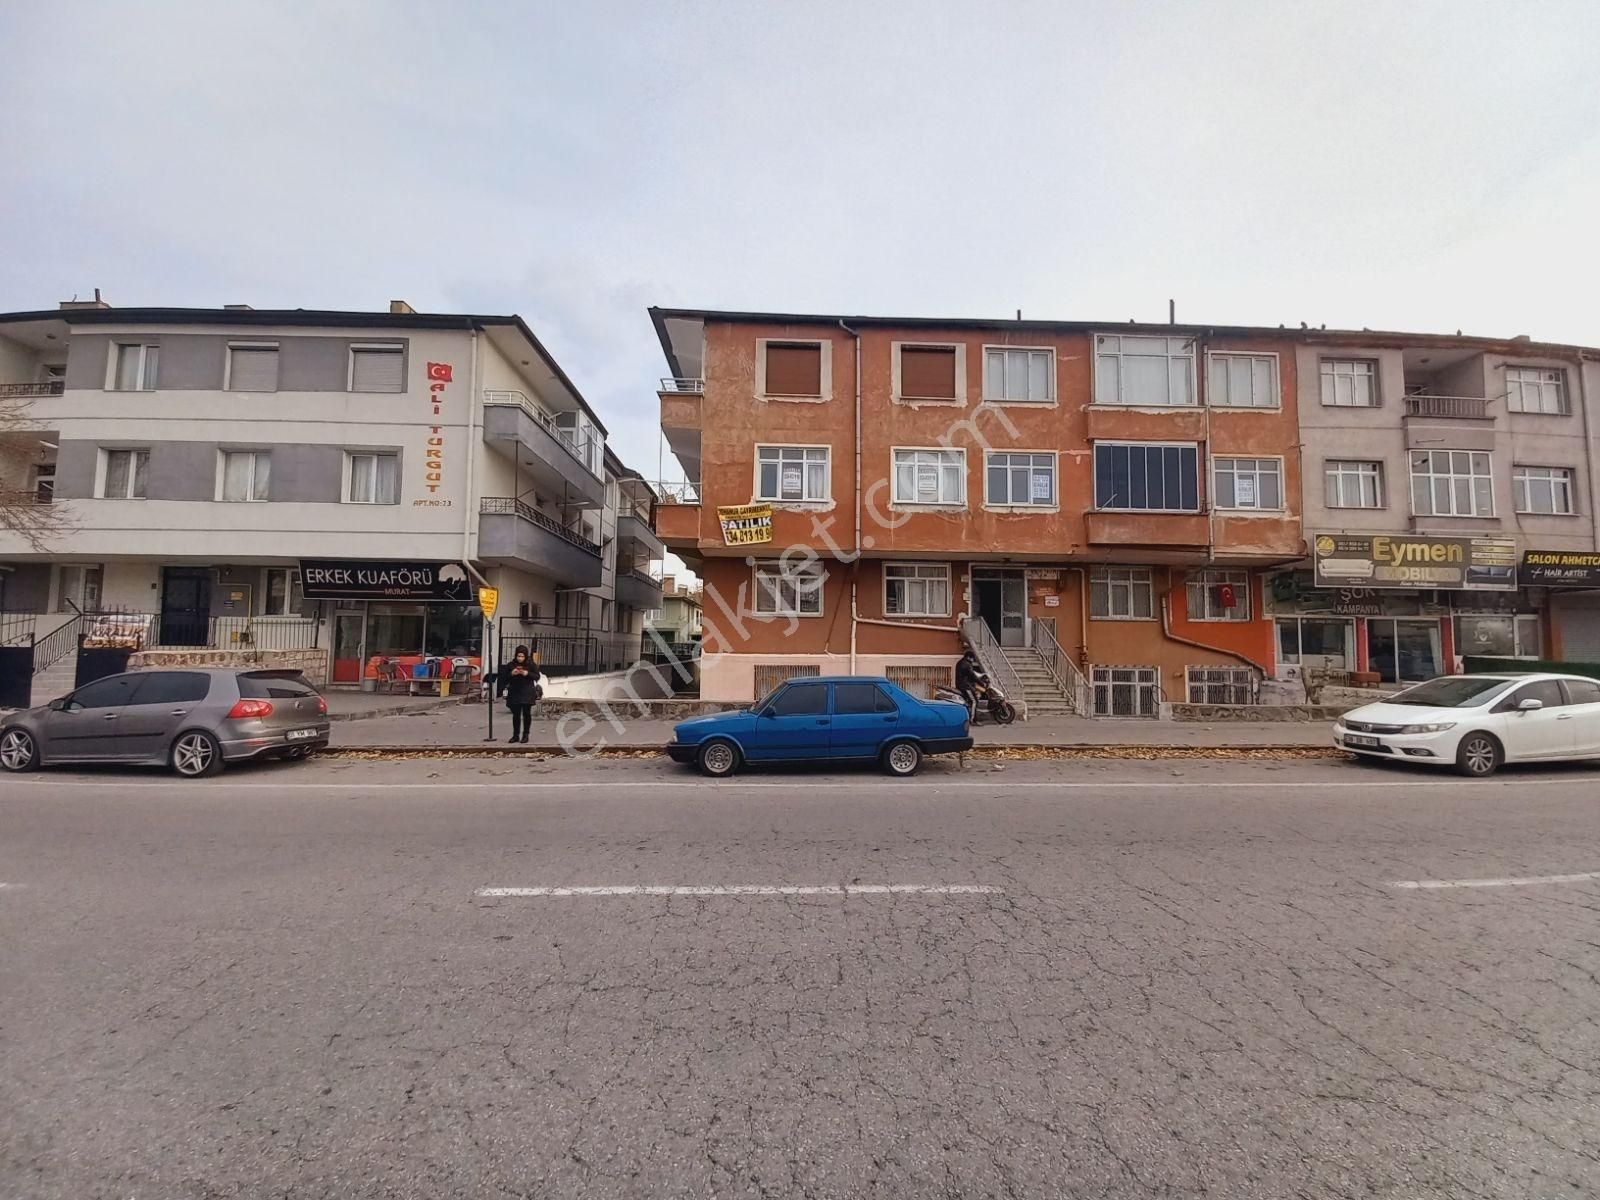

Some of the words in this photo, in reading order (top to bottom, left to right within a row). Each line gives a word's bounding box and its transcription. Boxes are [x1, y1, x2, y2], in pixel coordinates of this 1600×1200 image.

[425, 426, 443, 493] TURGUT
[721, 516, 772, 530] SATILIK
[1372, 536, 1463, 567] Eymen
[1526, 554, 1560, 565] SALON
[306, 568, 353, 584] ERKEK
[358, 567, 433, 585] KUAFÖRÜ
[384, 588, 410, 596] MURAT
[1336, 604, 1380, 614] KAMPANYA
